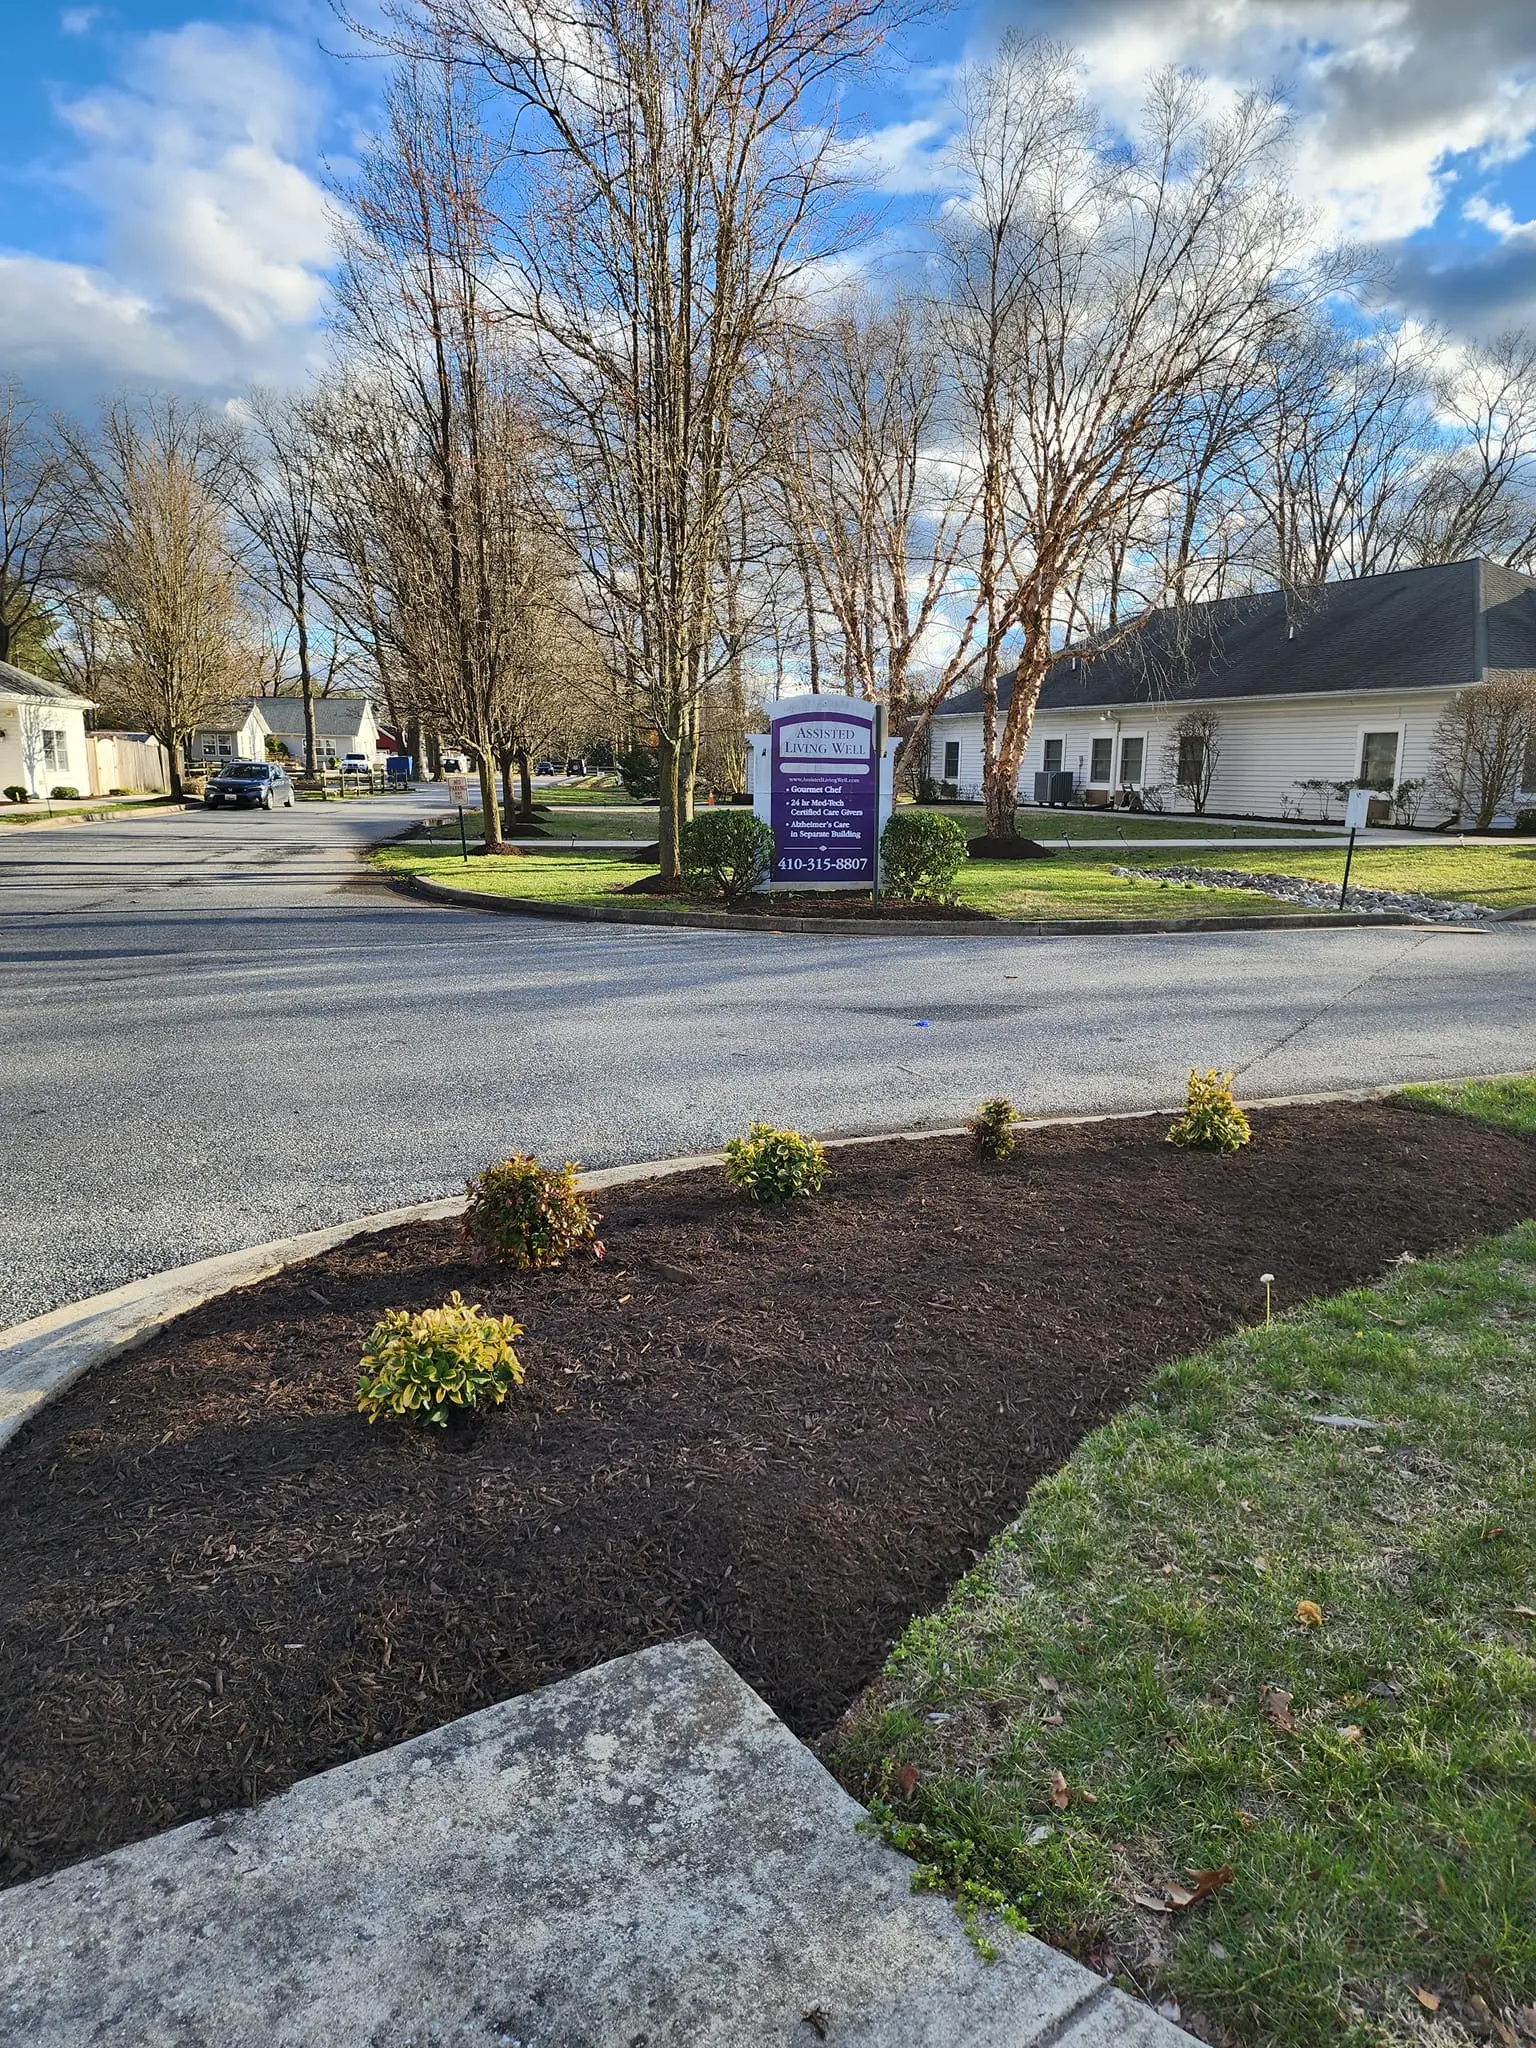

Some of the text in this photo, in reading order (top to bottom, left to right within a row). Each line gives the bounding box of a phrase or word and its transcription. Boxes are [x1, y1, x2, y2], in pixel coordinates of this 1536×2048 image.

[796, 727, 855, 739] ASSISTED
[785, 741, 866, 755] LIVING WELL
[791, 786, 842, 794] Gourmet Chef
[801, 799, 810, 807] hr
[811, 799, 844, 807] Med-Tech
[791, 830, 861, 839] in Separate Building
[777, 857, 868, 871] 410-315-8807
